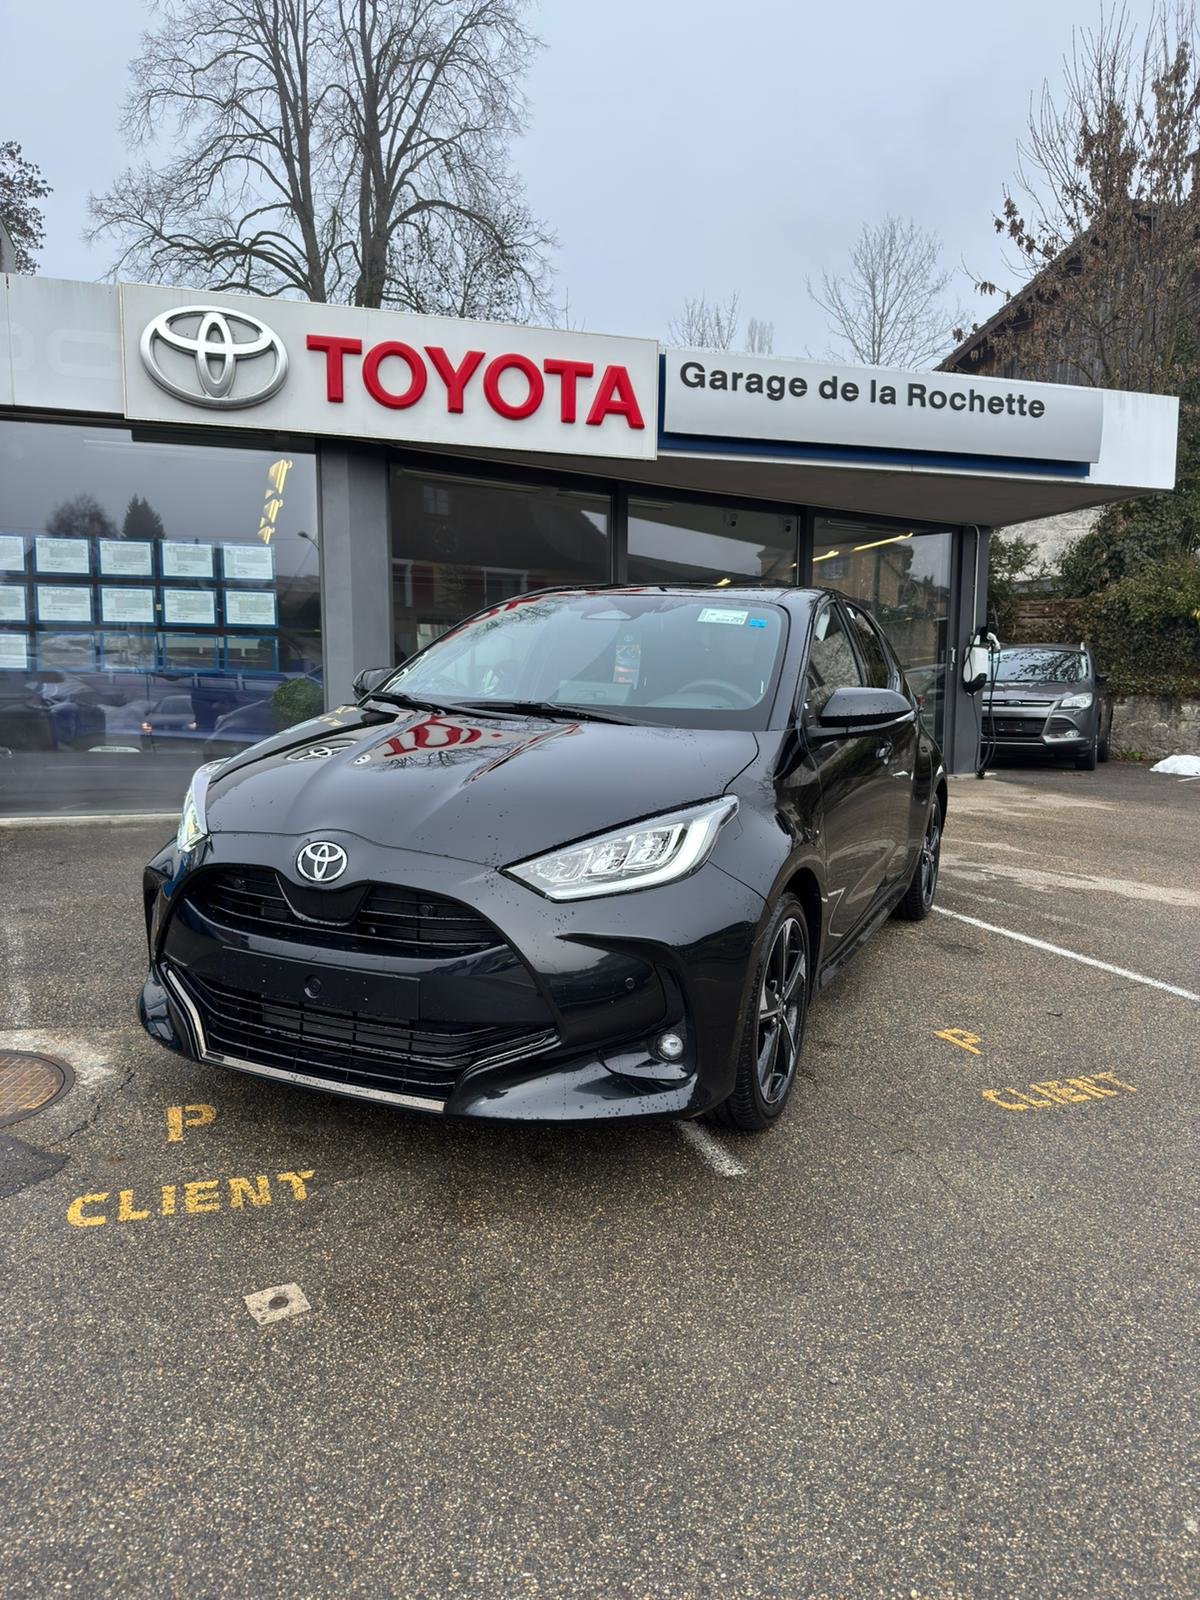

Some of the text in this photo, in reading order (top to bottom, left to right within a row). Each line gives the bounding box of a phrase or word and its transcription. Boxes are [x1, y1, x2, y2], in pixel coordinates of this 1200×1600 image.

[306, 334, 645, 430] TOYOTA
[679, 361, 1046, 419] Garage de la Rochette
[934, 1028, 982, 1055] P
[982, 1071, 1137, 1111] CLIENT
[166, 1103, 217, 1142] P
[66, 1169, 315, 1228] CLIENT
